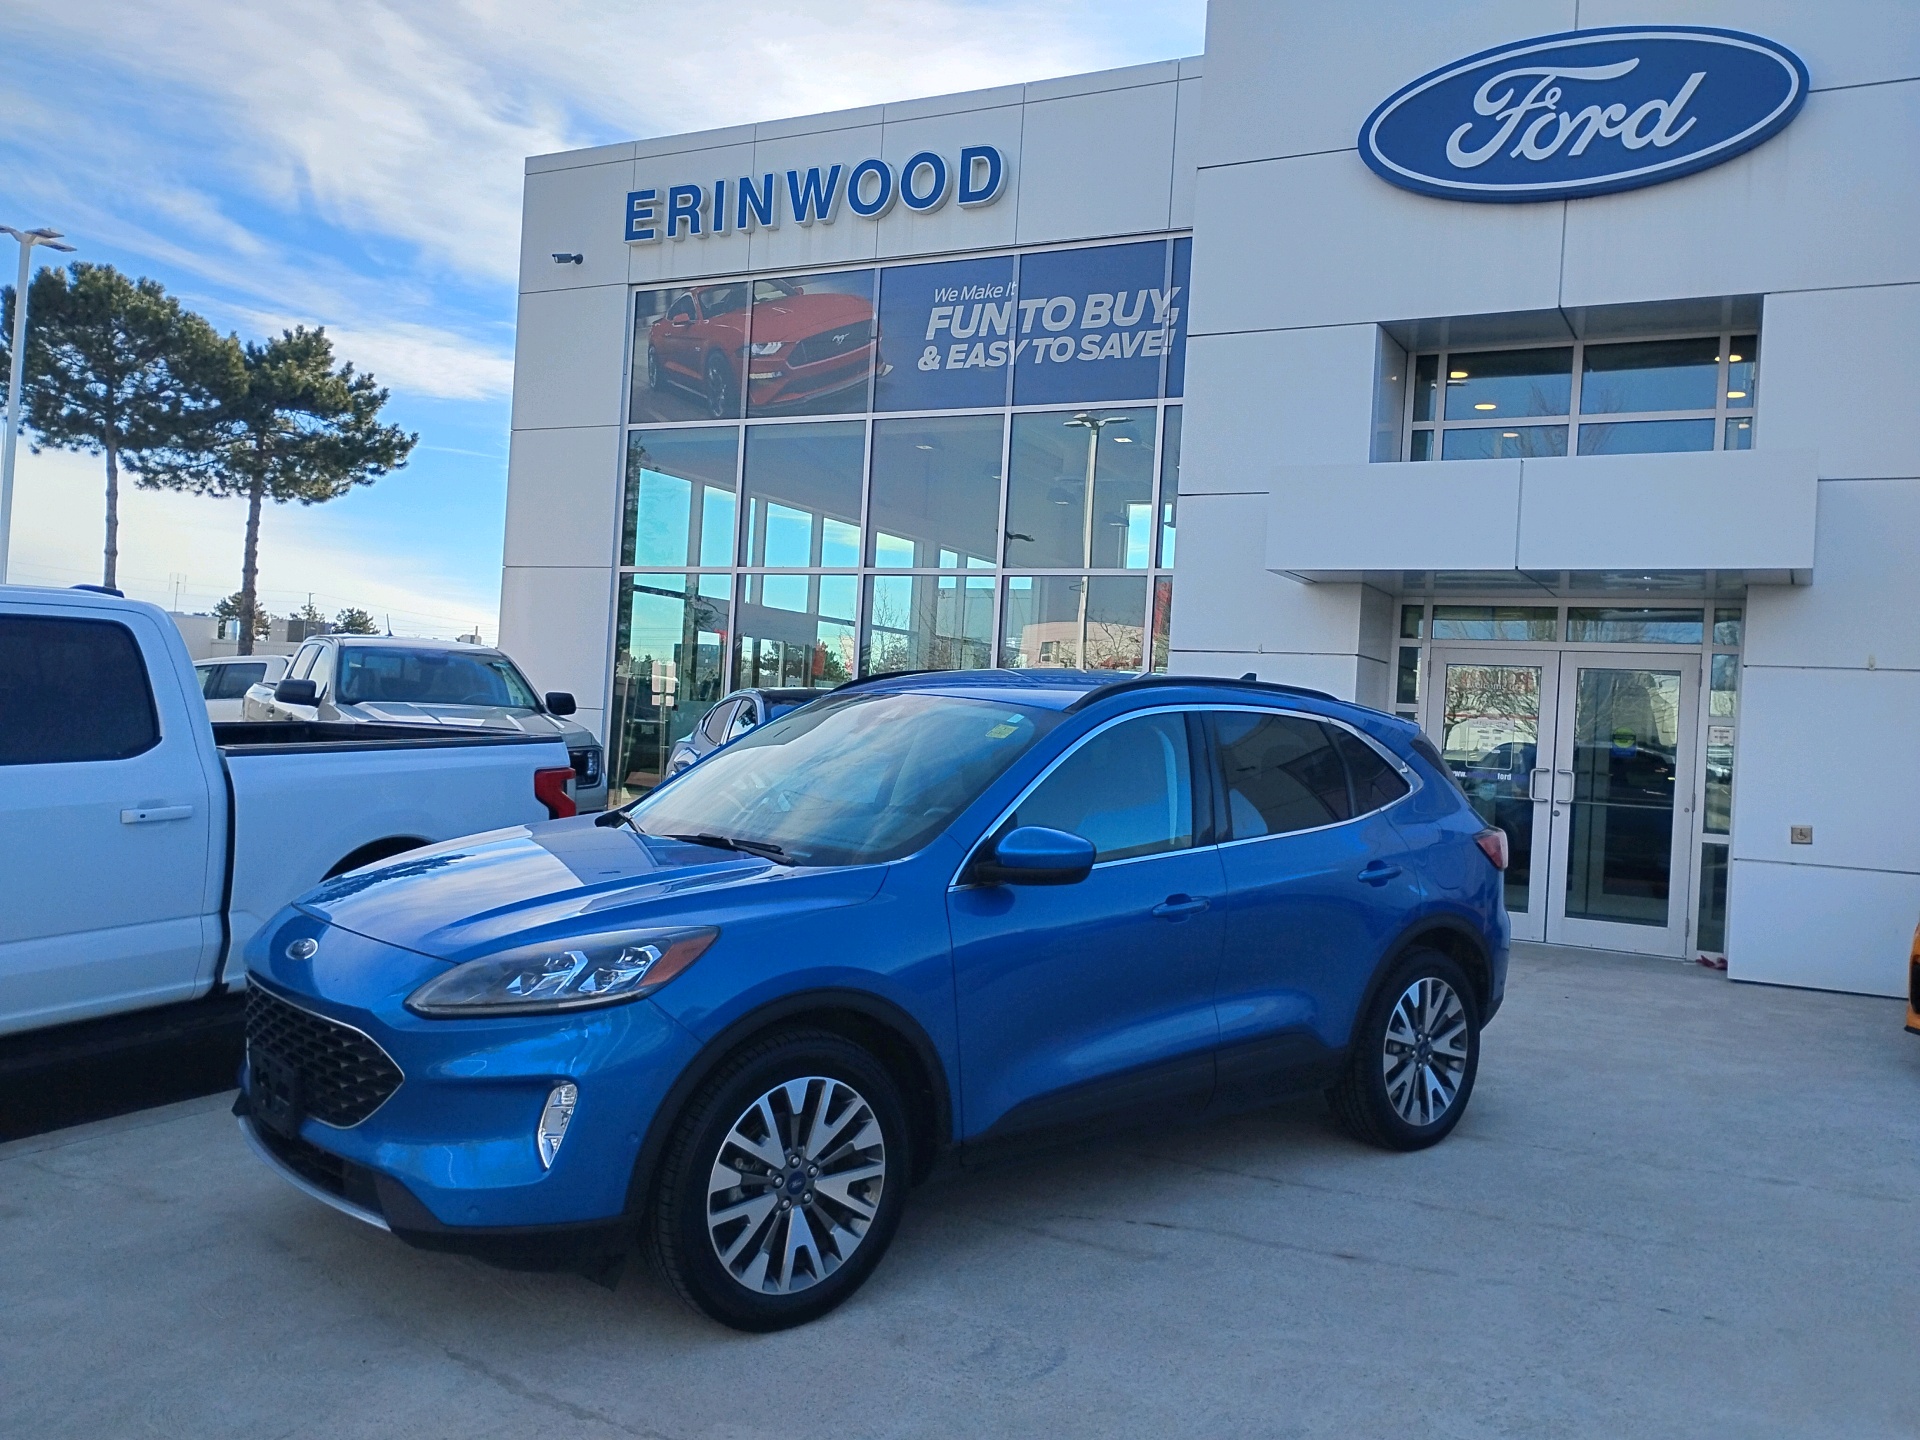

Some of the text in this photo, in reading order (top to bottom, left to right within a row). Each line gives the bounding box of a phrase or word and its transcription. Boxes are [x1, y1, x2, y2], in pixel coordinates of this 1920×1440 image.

[1446, 58, 1707, 168] Ford
[624, 145, 1007, 245] ERINWOOD
[925, 286, 1181, 341] FUN TO BUY,
[934, 287, 958, 303] We
[960, 283, 1001, 301] Make
[917, 328, 1176, 371] & EASY TO SAVE!
